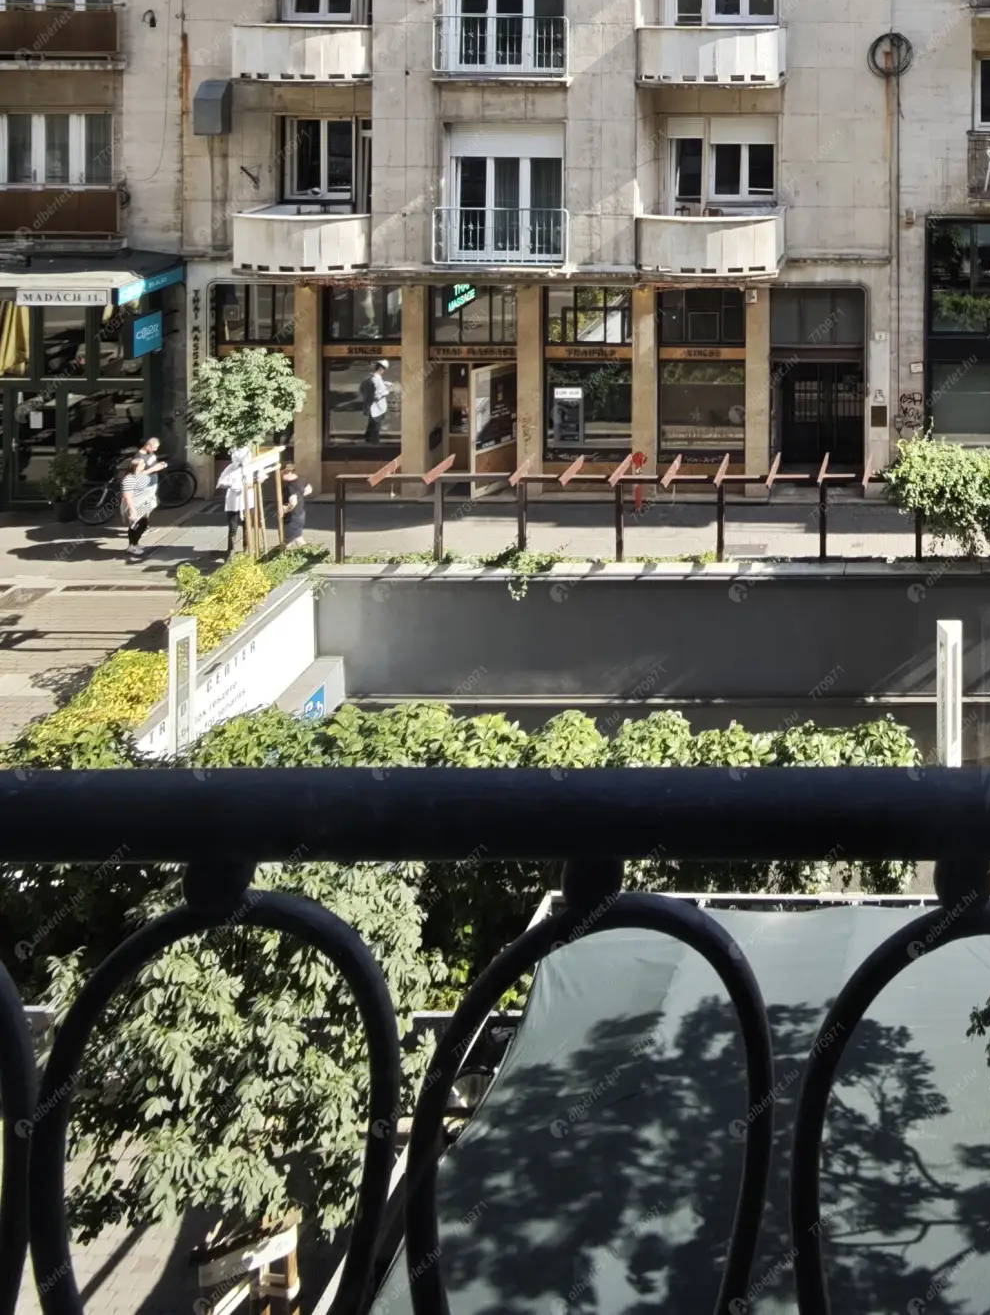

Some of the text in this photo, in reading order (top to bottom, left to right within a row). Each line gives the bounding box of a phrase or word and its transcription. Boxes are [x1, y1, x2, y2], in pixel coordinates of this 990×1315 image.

[22, 291, 103, 303] MADÁCH 11.
[192, 289, 201, 320] THAI
